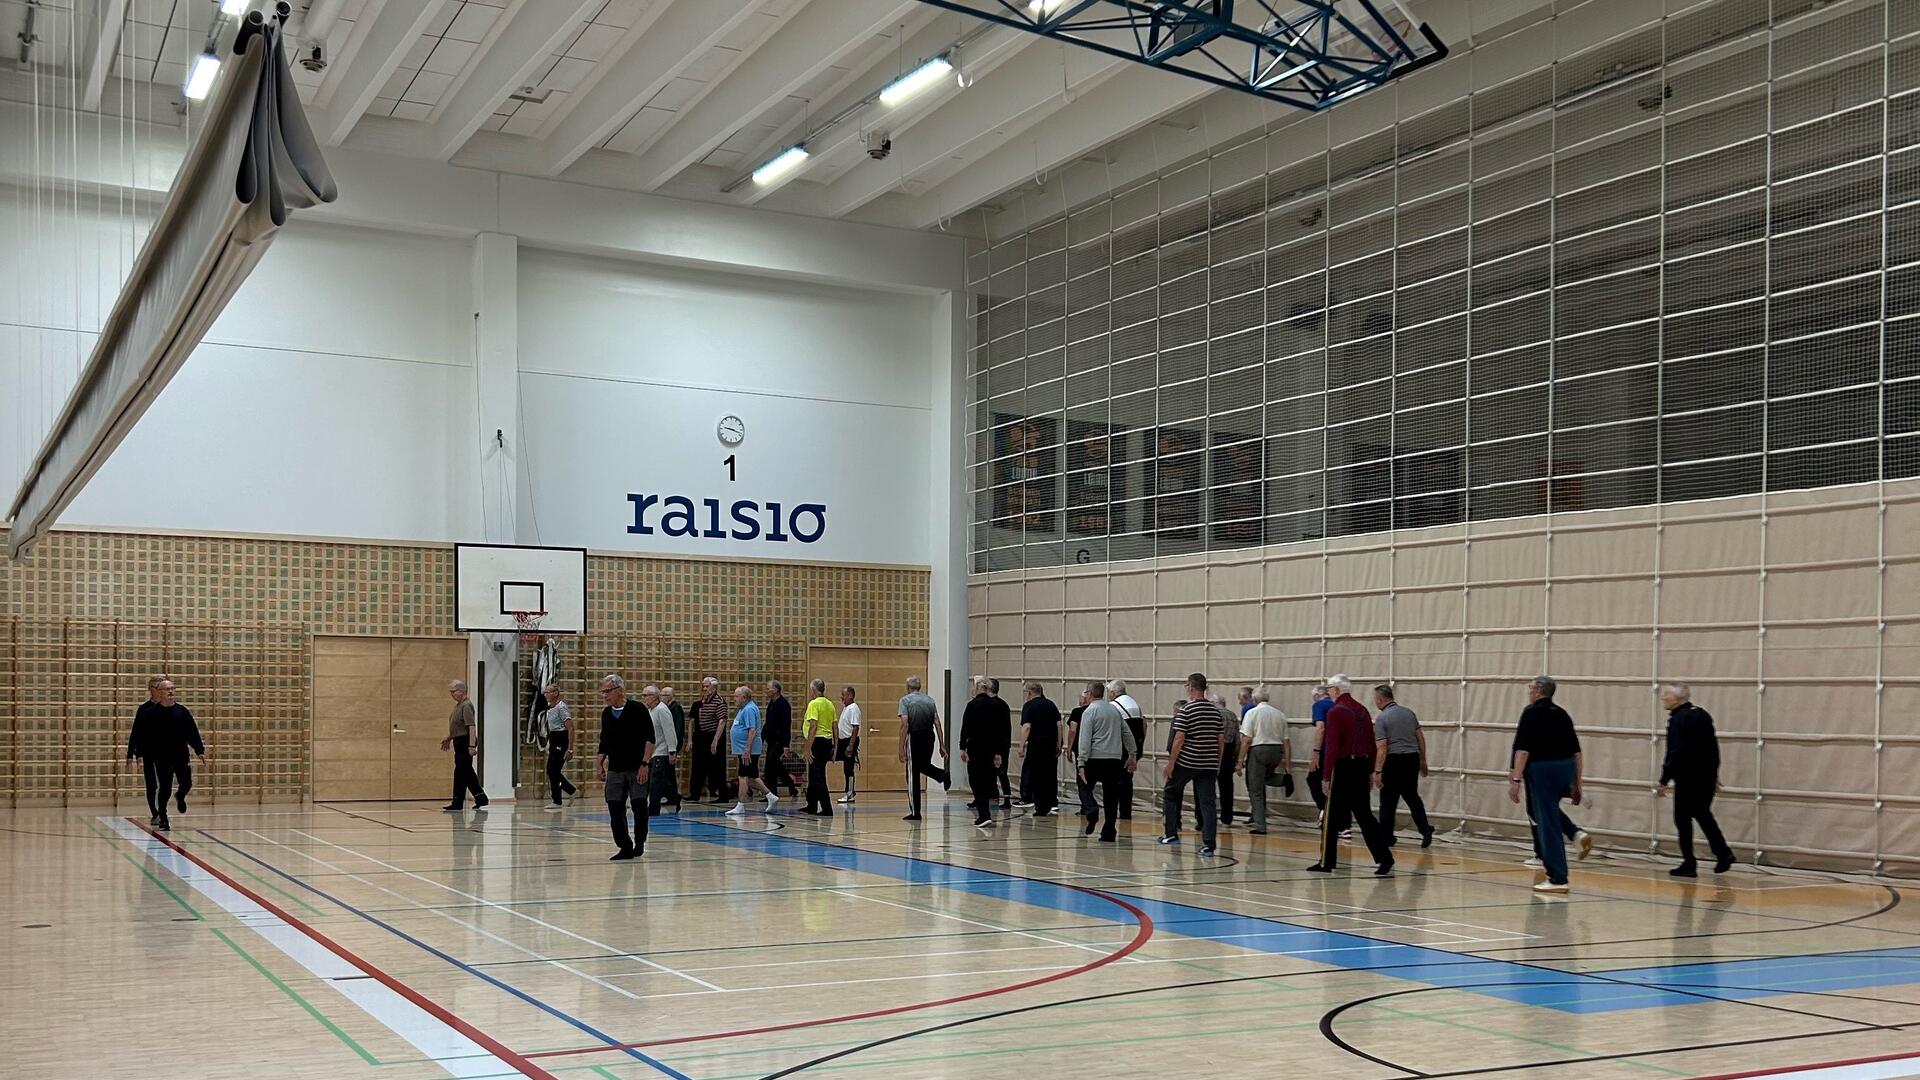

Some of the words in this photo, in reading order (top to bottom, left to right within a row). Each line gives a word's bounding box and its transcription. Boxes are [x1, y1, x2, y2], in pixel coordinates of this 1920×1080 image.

[723, 454, 736, 482] 1
[626, 493, 827, 544] raisio
[1076, 549, 1090, 564] G
